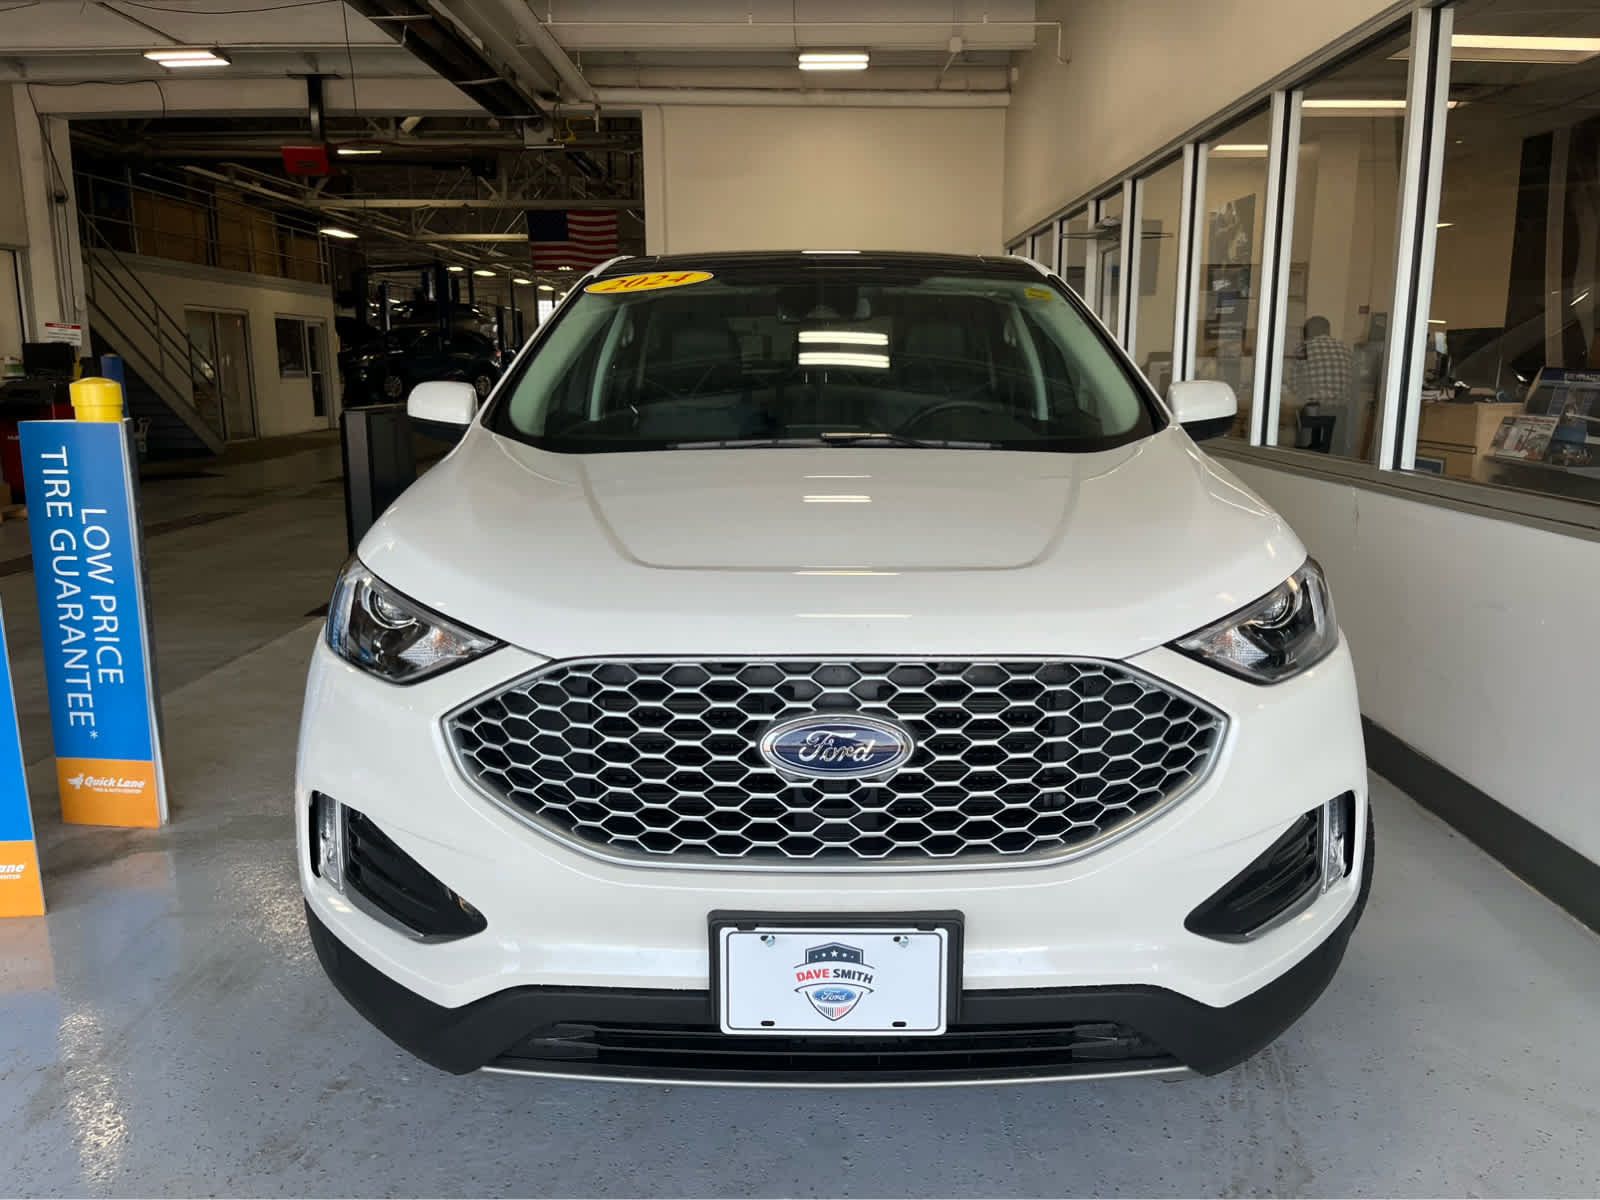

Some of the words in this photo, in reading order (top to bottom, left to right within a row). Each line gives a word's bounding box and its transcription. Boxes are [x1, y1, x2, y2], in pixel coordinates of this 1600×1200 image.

[601, 272, 695, 291] 2024
[40, 445, 73, 518] TIRE
[80, 508, 115, 585] LOW
[90, 594, 125, 685] PRICE
[798, 730, 877, 762] Ford
[84, 776, 116, 788] Quick
[116, 778, 145, 788] Lane
[0, 863, 25, 873] ane
[796, 968, 830, 982] DAVE
[832, 968, 873, 984] SMITH
